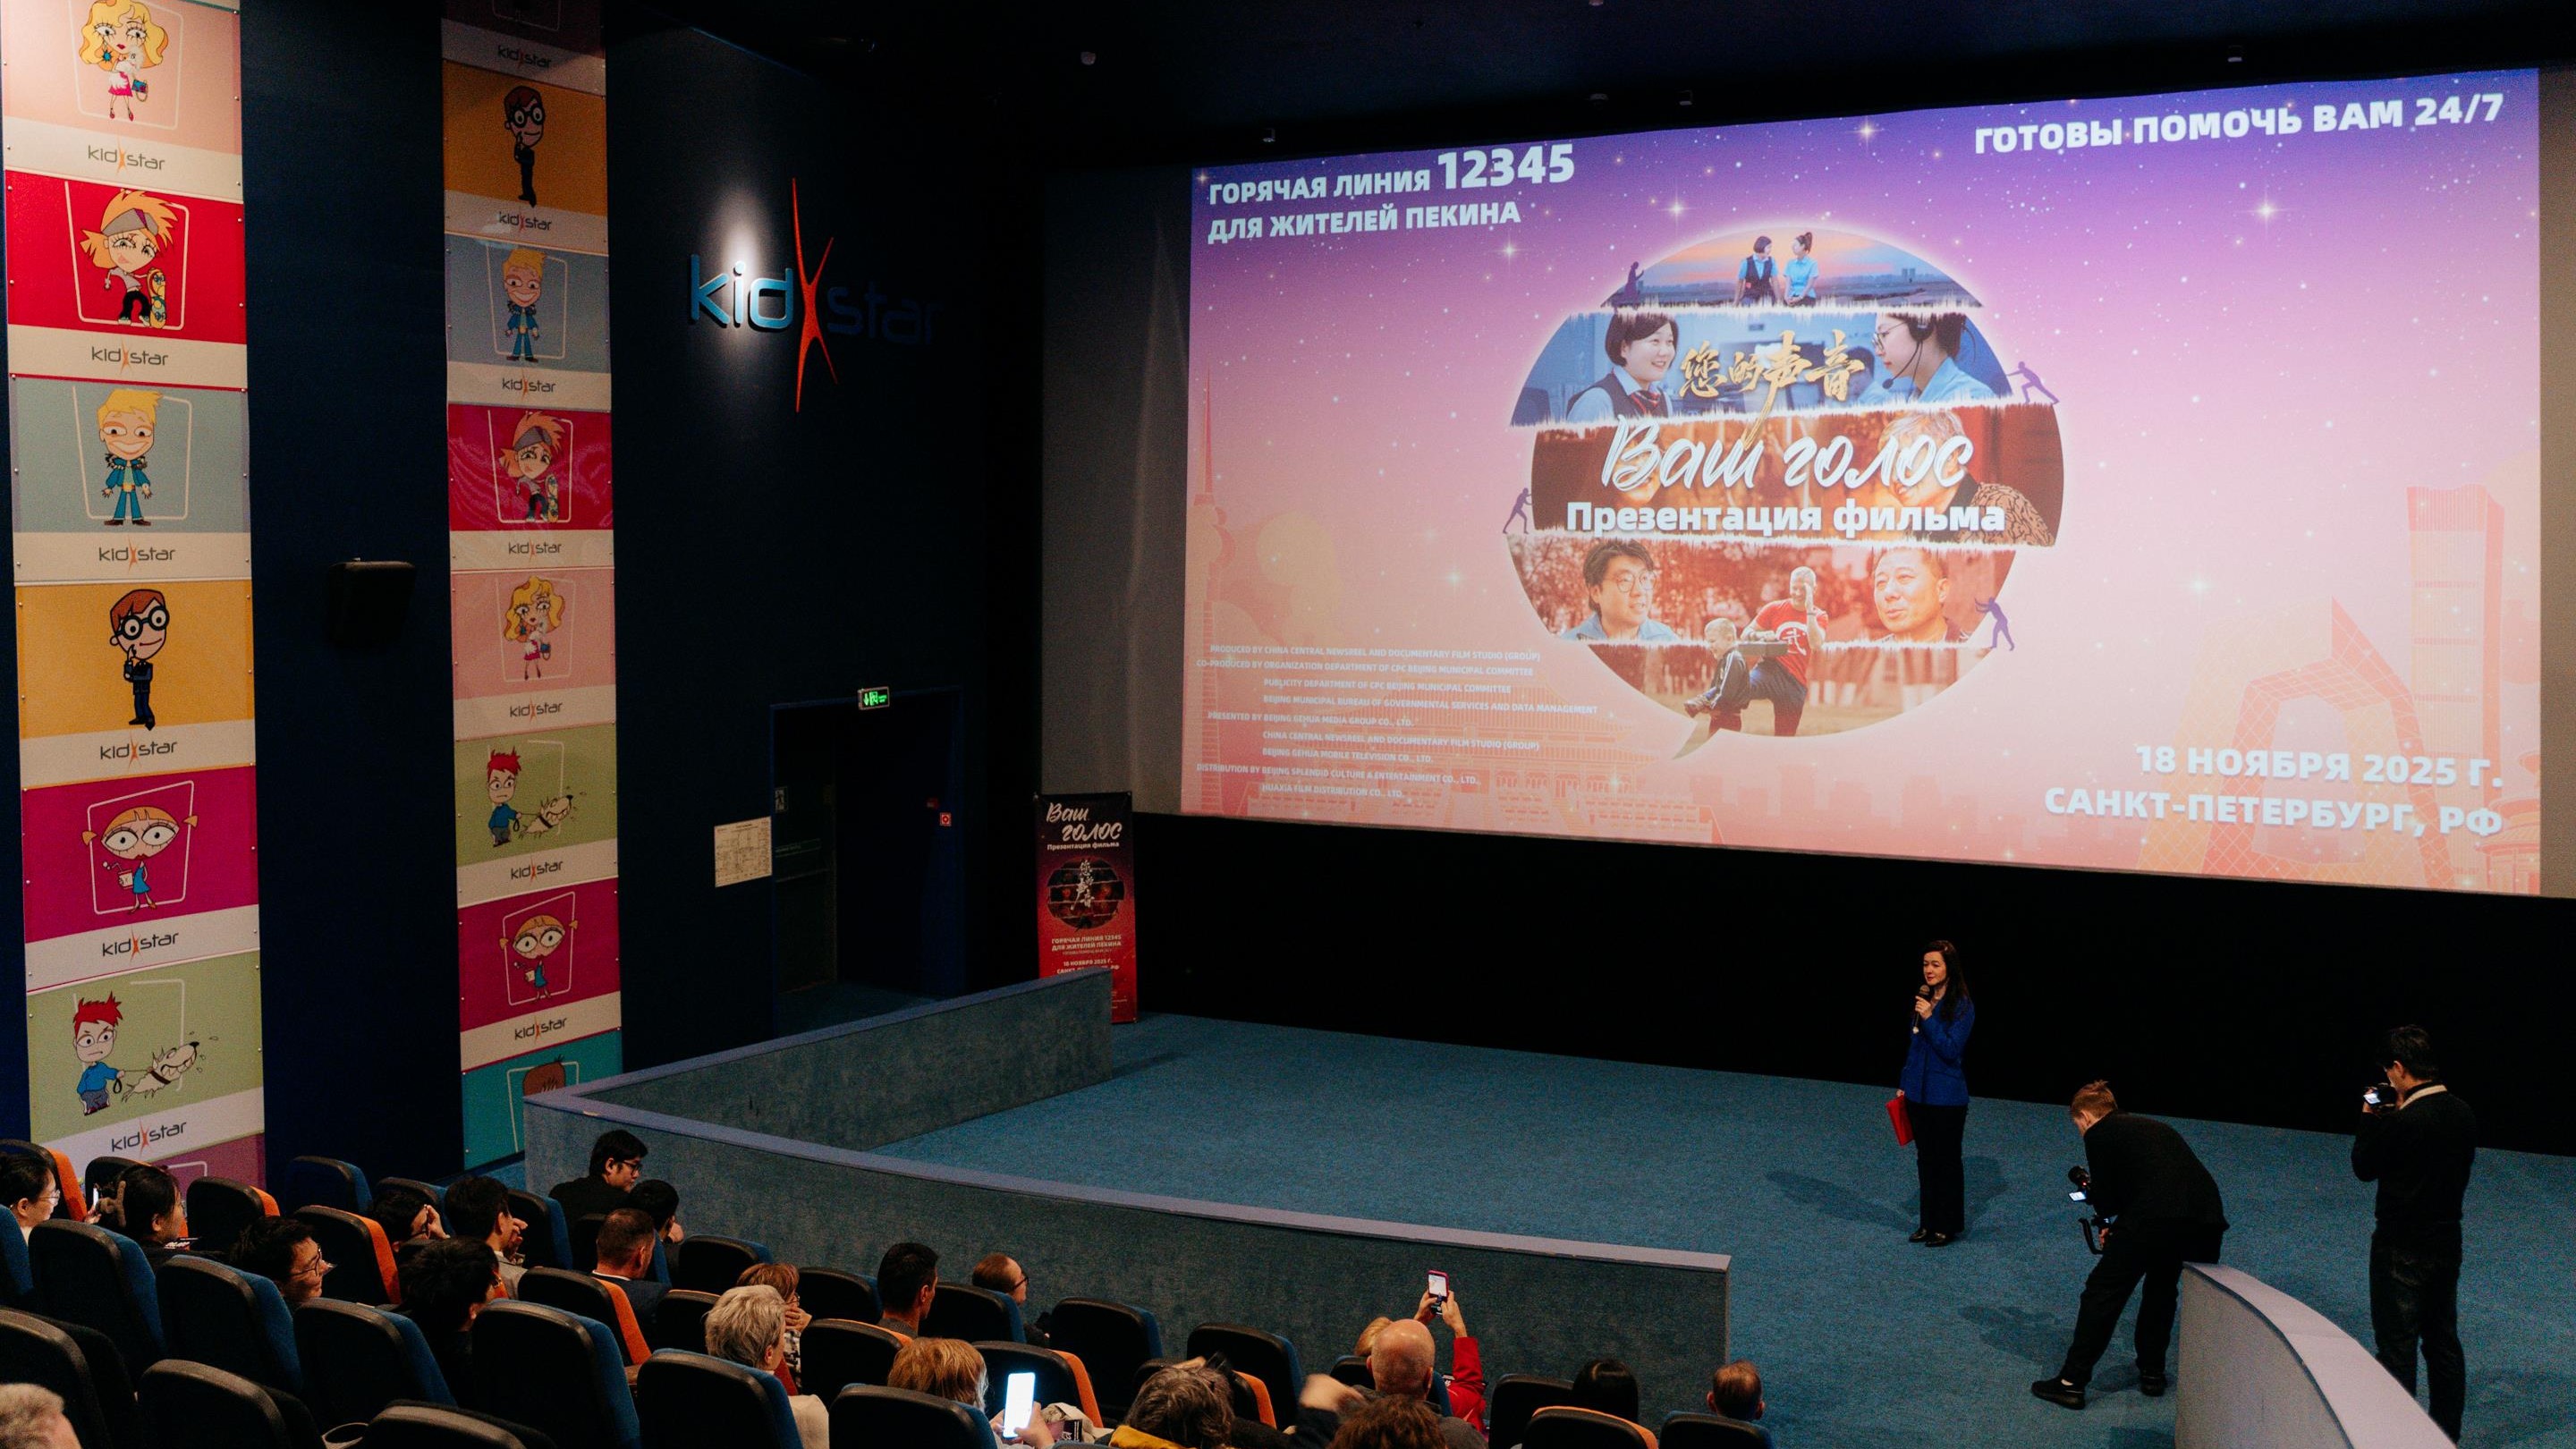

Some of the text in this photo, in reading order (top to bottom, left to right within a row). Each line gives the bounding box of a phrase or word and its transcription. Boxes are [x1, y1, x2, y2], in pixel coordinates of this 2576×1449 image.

[1975, 93, 2504, 155] ГОТОВЫ ПОМОЧЬ ВАМ 24/7
[1209, 143, 1575, 205] ГОРЯЧАЯ ЛИНИЯ 12345
[1208, 201, 1521, 245] ДЛЯ ЖИТЕЛЕЙ ПЕКИНА
[1679, 328, 1866, 450] 您的声音
[1601, 415, 1975, 491] Ваш голос
[1566, 498, 2007, 539] Презентация фильма
[2135, 745, 2504, 789] 18 НОЯБРЯ 2025 Г.
[1046, 802, 1089, 823] Ваш
[1062, 822, 1123, 842] голос
[2045, 786, 2504, 838] САНКТ-ПЕТЕРБУРГ, РФ
[1047, 842, 1120, 852] Презентация фильма
